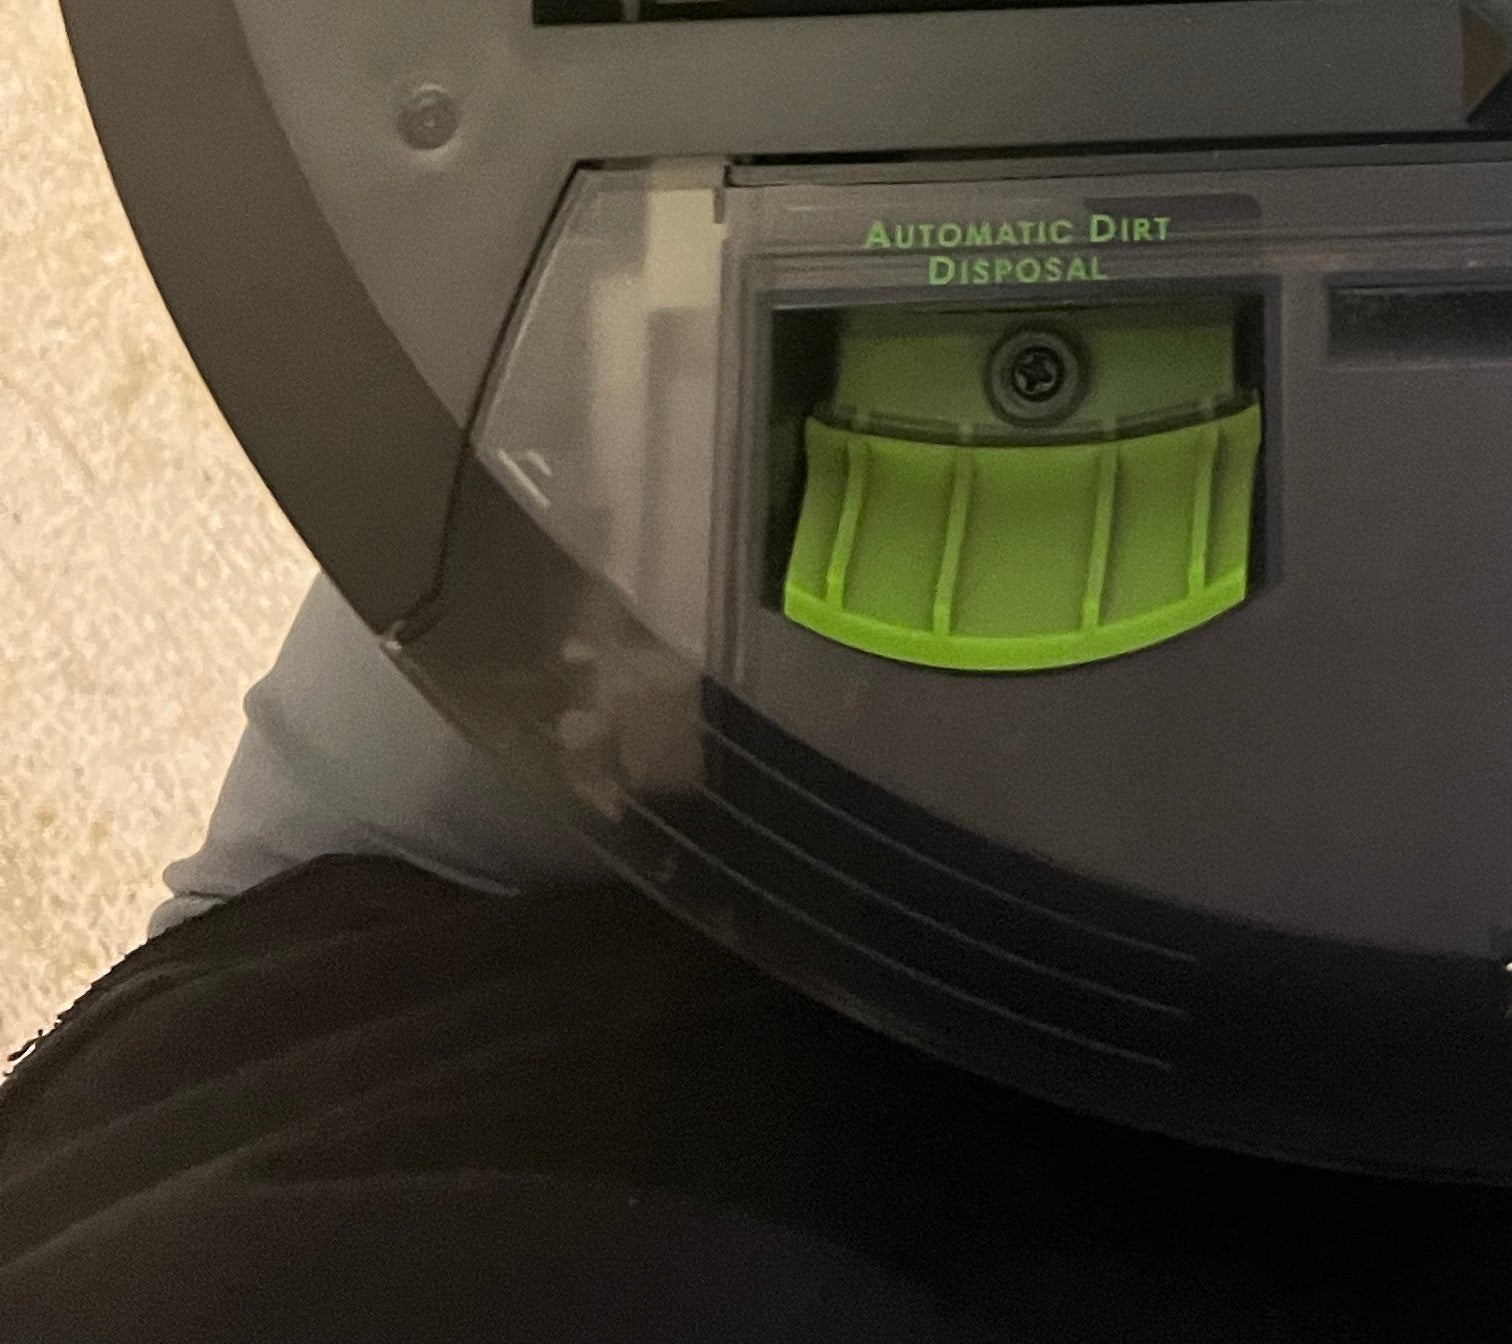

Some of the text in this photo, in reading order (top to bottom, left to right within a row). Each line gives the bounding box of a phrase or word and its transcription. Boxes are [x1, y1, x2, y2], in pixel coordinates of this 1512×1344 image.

[865, 214, 1171, 250] AUTOMATIC DIRT
[929, 255, 1109, 286] DISPOSAL
